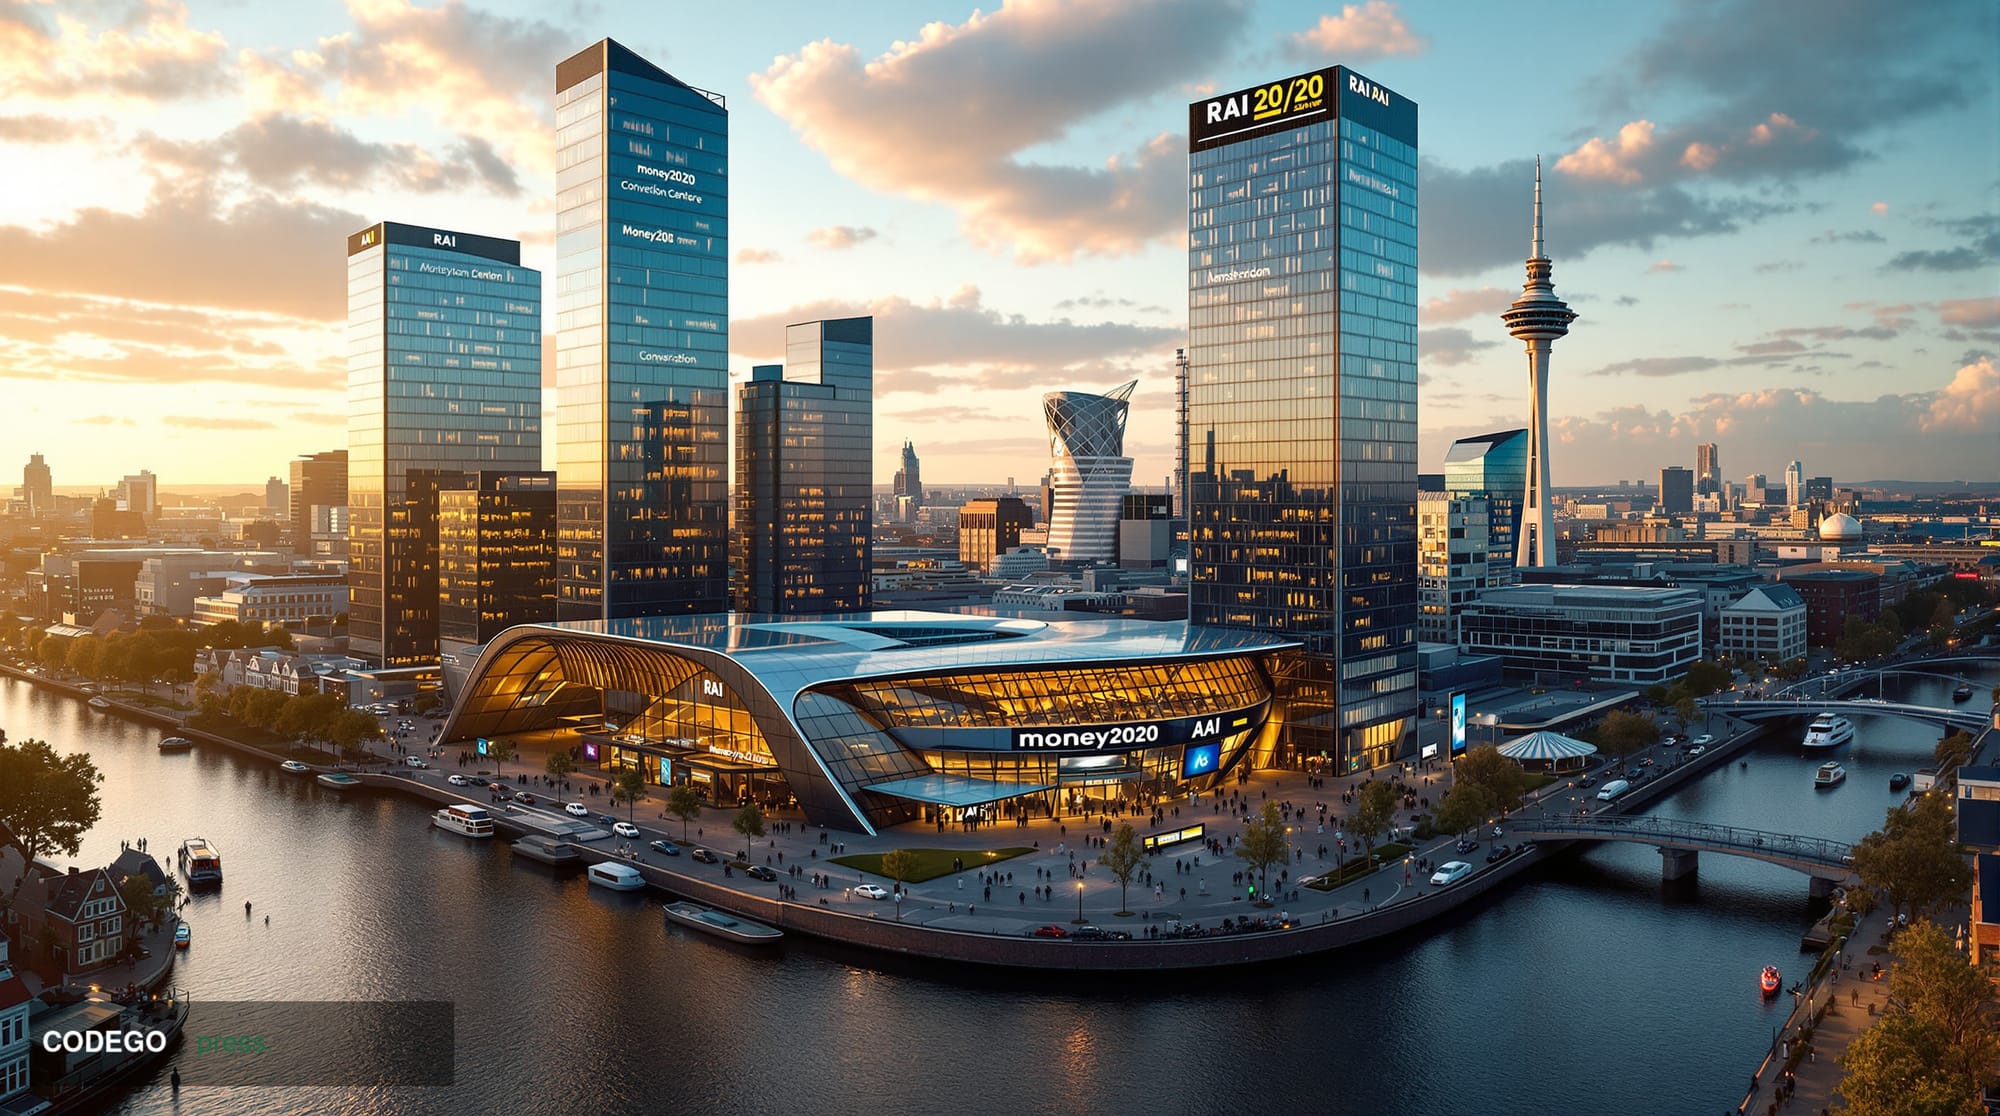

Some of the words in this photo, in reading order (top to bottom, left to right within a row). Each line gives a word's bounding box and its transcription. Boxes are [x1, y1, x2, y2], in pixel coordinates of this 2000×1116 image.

[1349, 74, 1370, 98] RAI
[1207, 94, 1249, 124] RAI
[1253, 74, 1324, 113] 20/20
[637, 164, 696, 186] money2020
[433, 233, 456, 248] RAI
[704, 679, 723, 698] RAI
[1019, 724, 1159, 749] money2020
